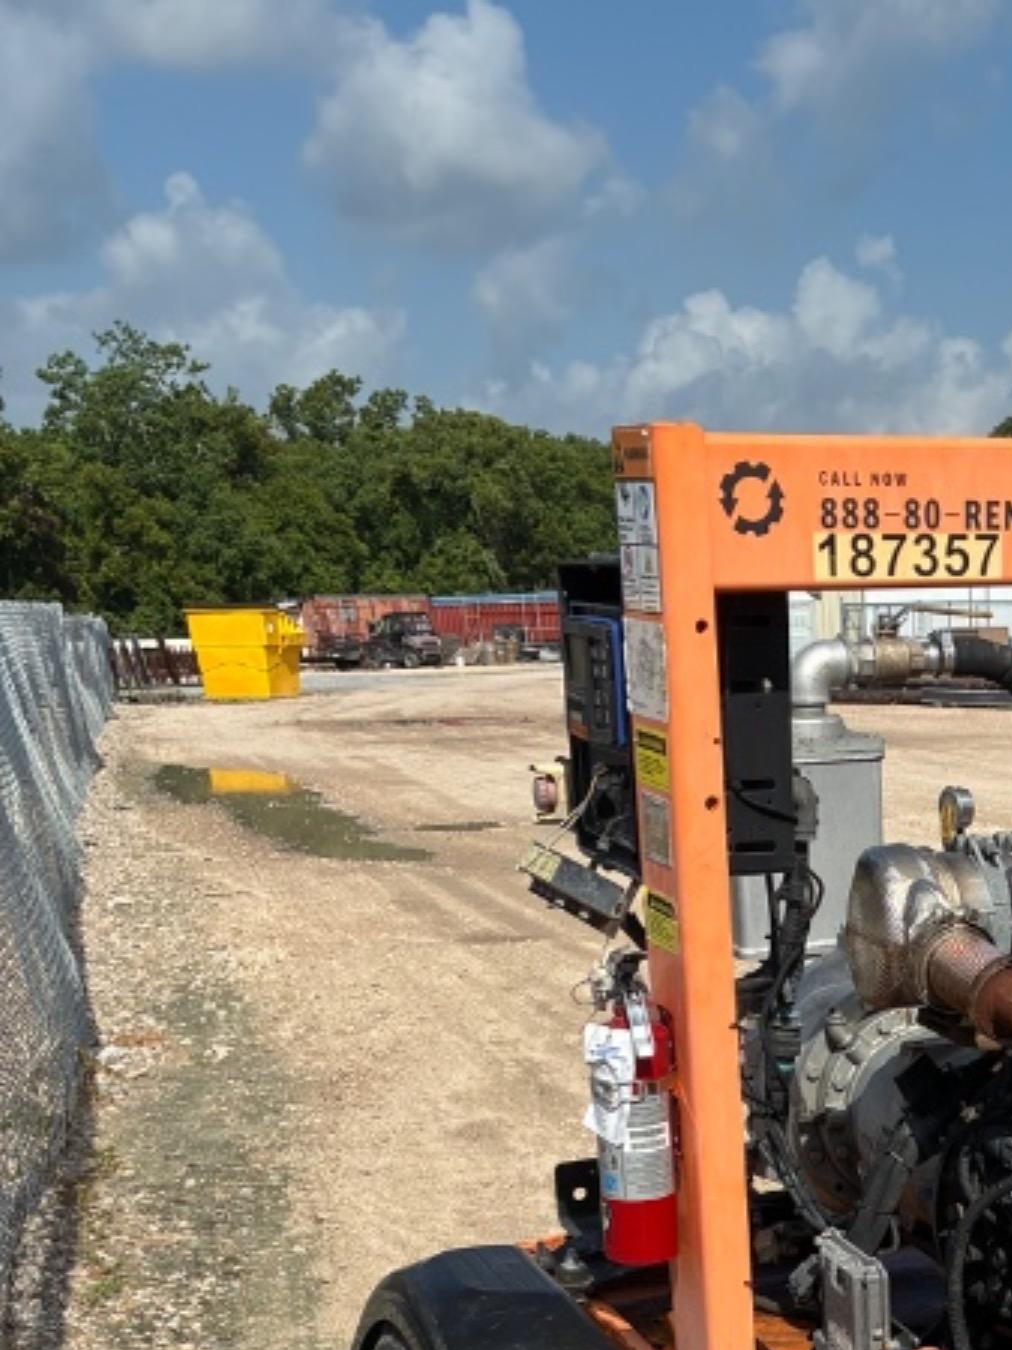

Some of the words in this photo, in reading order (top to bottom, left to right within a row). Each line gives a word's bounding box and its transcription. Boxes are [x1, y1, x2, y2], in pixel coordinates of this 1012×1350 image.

[818, 470, 862, 487] CALL
[870, 472, 908, 487] NOW
[818, 532, 1000, 578] 187357
